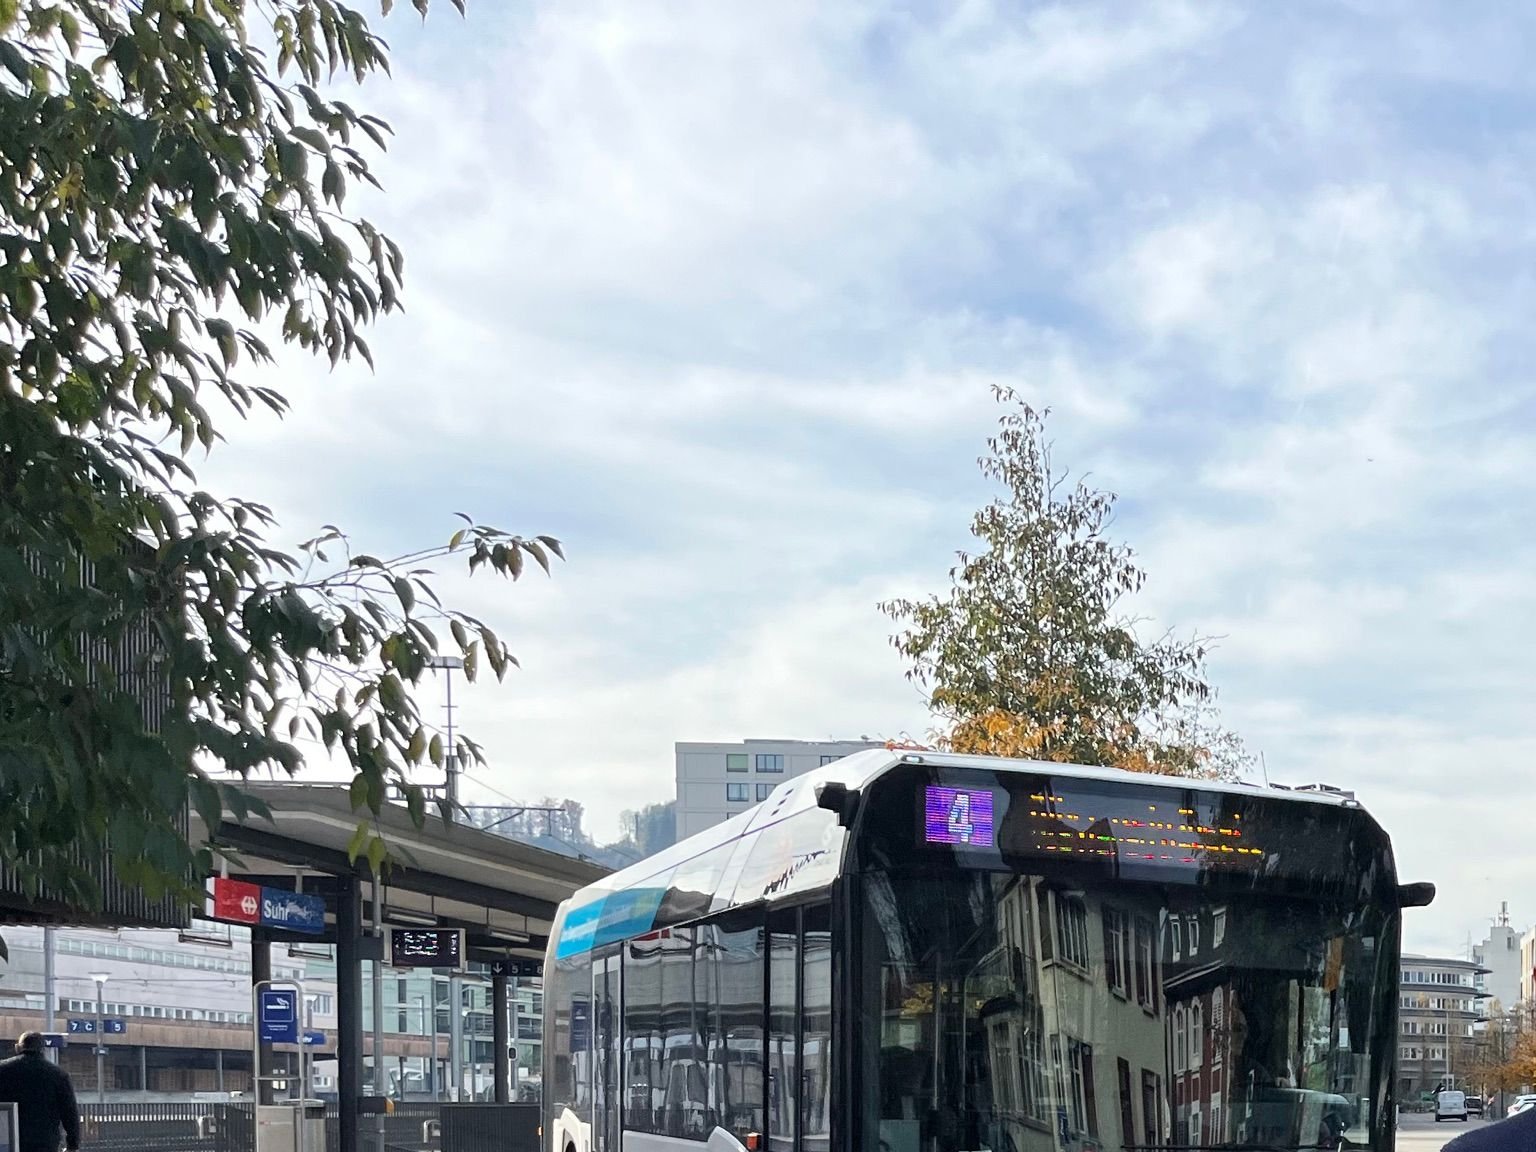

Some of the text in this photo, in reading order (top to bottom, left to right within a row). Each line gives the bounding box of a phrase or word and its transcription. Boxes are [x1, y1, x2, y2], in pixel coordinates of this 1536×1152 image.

[948, 793, 974, 843] 4
[264, 900, 289, 921] Suhr
[512, 965, 519, 974] 5
[71, 1022, 78, 1031] 7
[114, 1023, 121, 1032] 5
